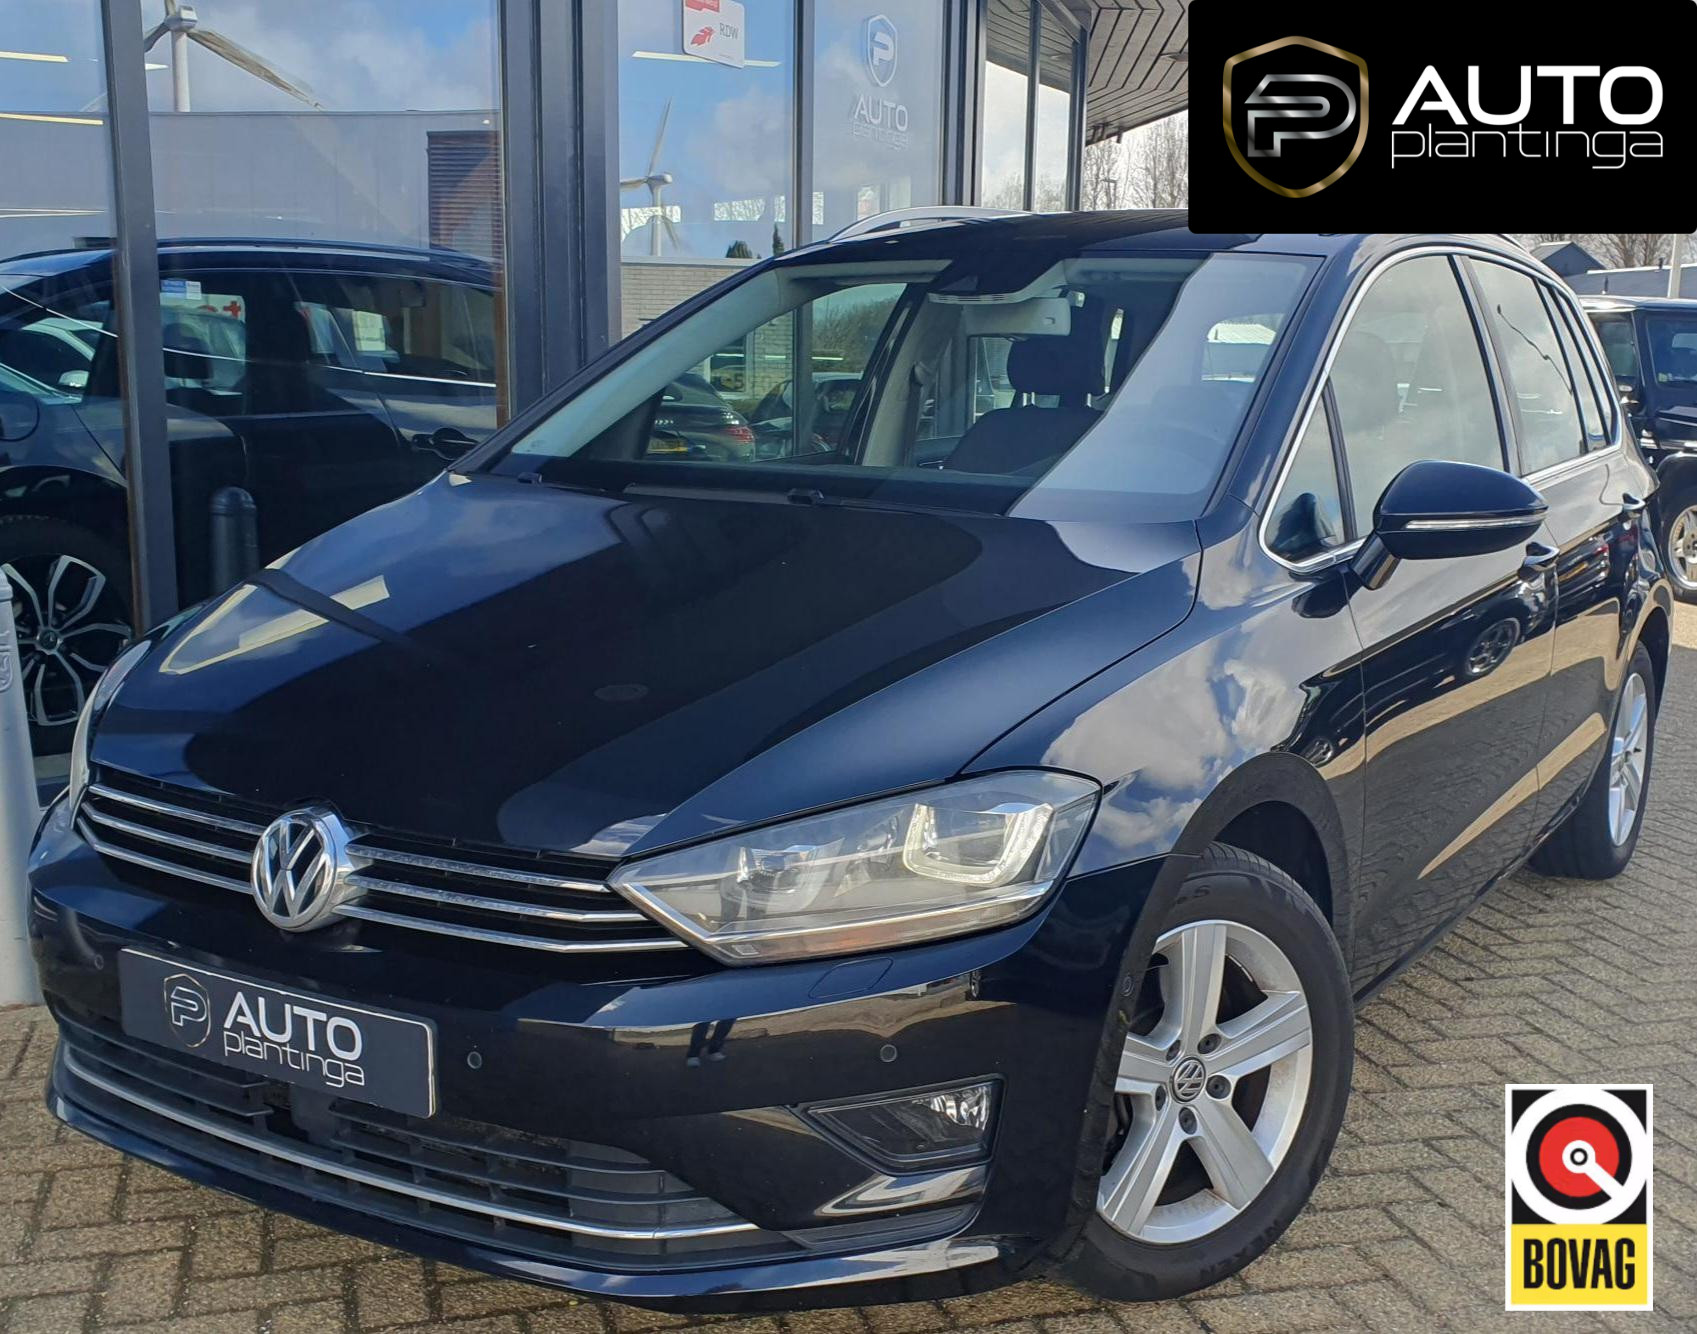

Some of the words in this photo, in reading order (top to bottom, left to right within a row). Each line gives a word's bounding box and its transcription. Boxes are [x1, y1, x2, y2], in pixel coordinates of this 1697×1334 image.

[719, 22, 739, 40] RDW
[854, 94, 908, 132] AUTO
[223, 991, 363, 1061] AUTO
[223, 1030, 365, 1087] plantinga
